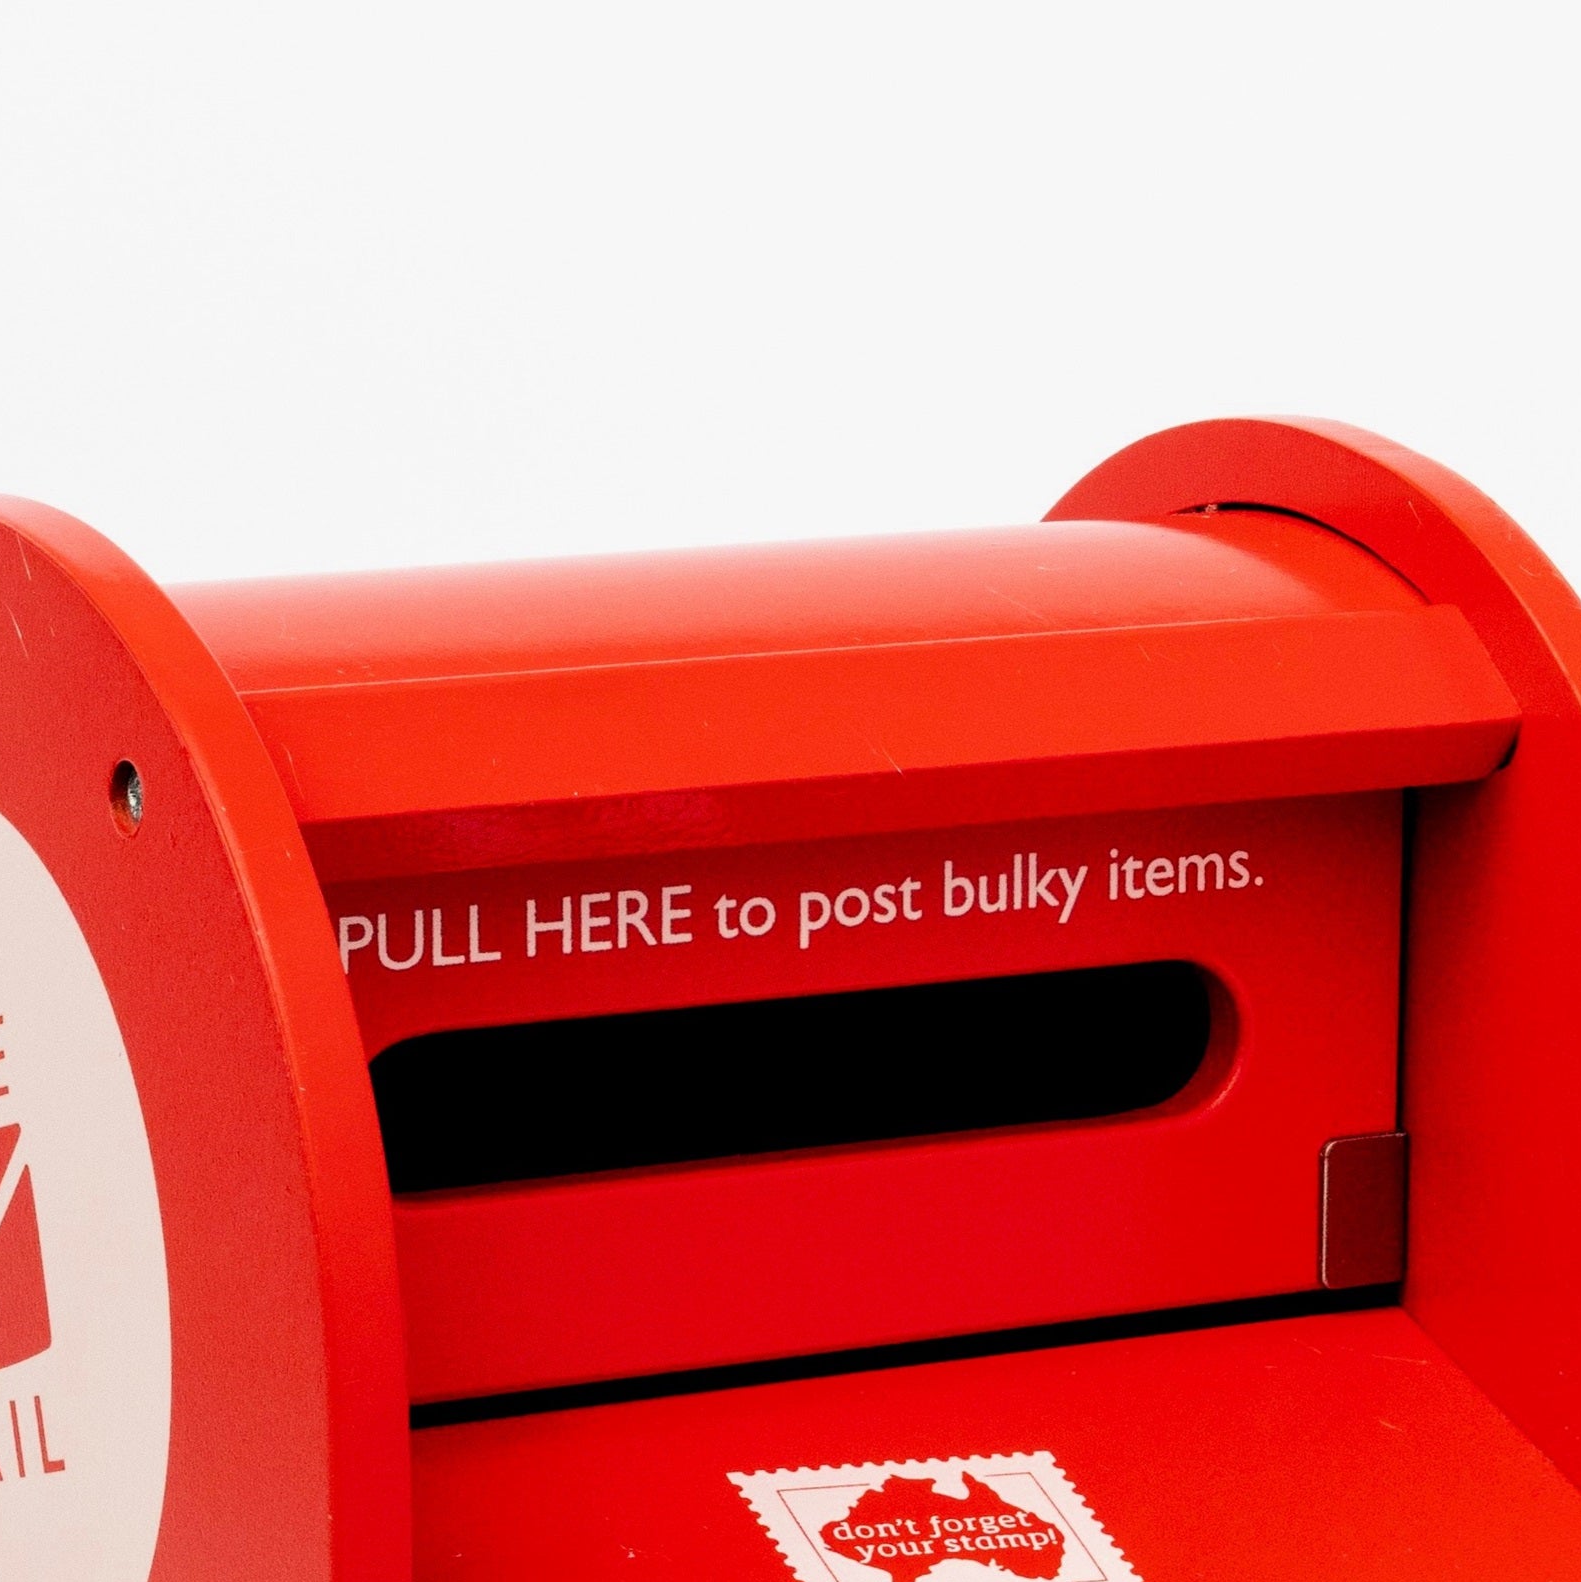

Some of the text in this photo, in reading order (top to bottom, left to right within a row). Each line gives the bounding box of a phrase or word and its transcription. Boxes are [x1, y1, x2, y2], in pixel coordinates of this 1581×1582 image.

[339, 848, 1264, 974] PULL HERE to post bulky items.
[832, 1511, 1032, 1541] don't forget
[855, 1529, 1059, 1564] your stamp!
